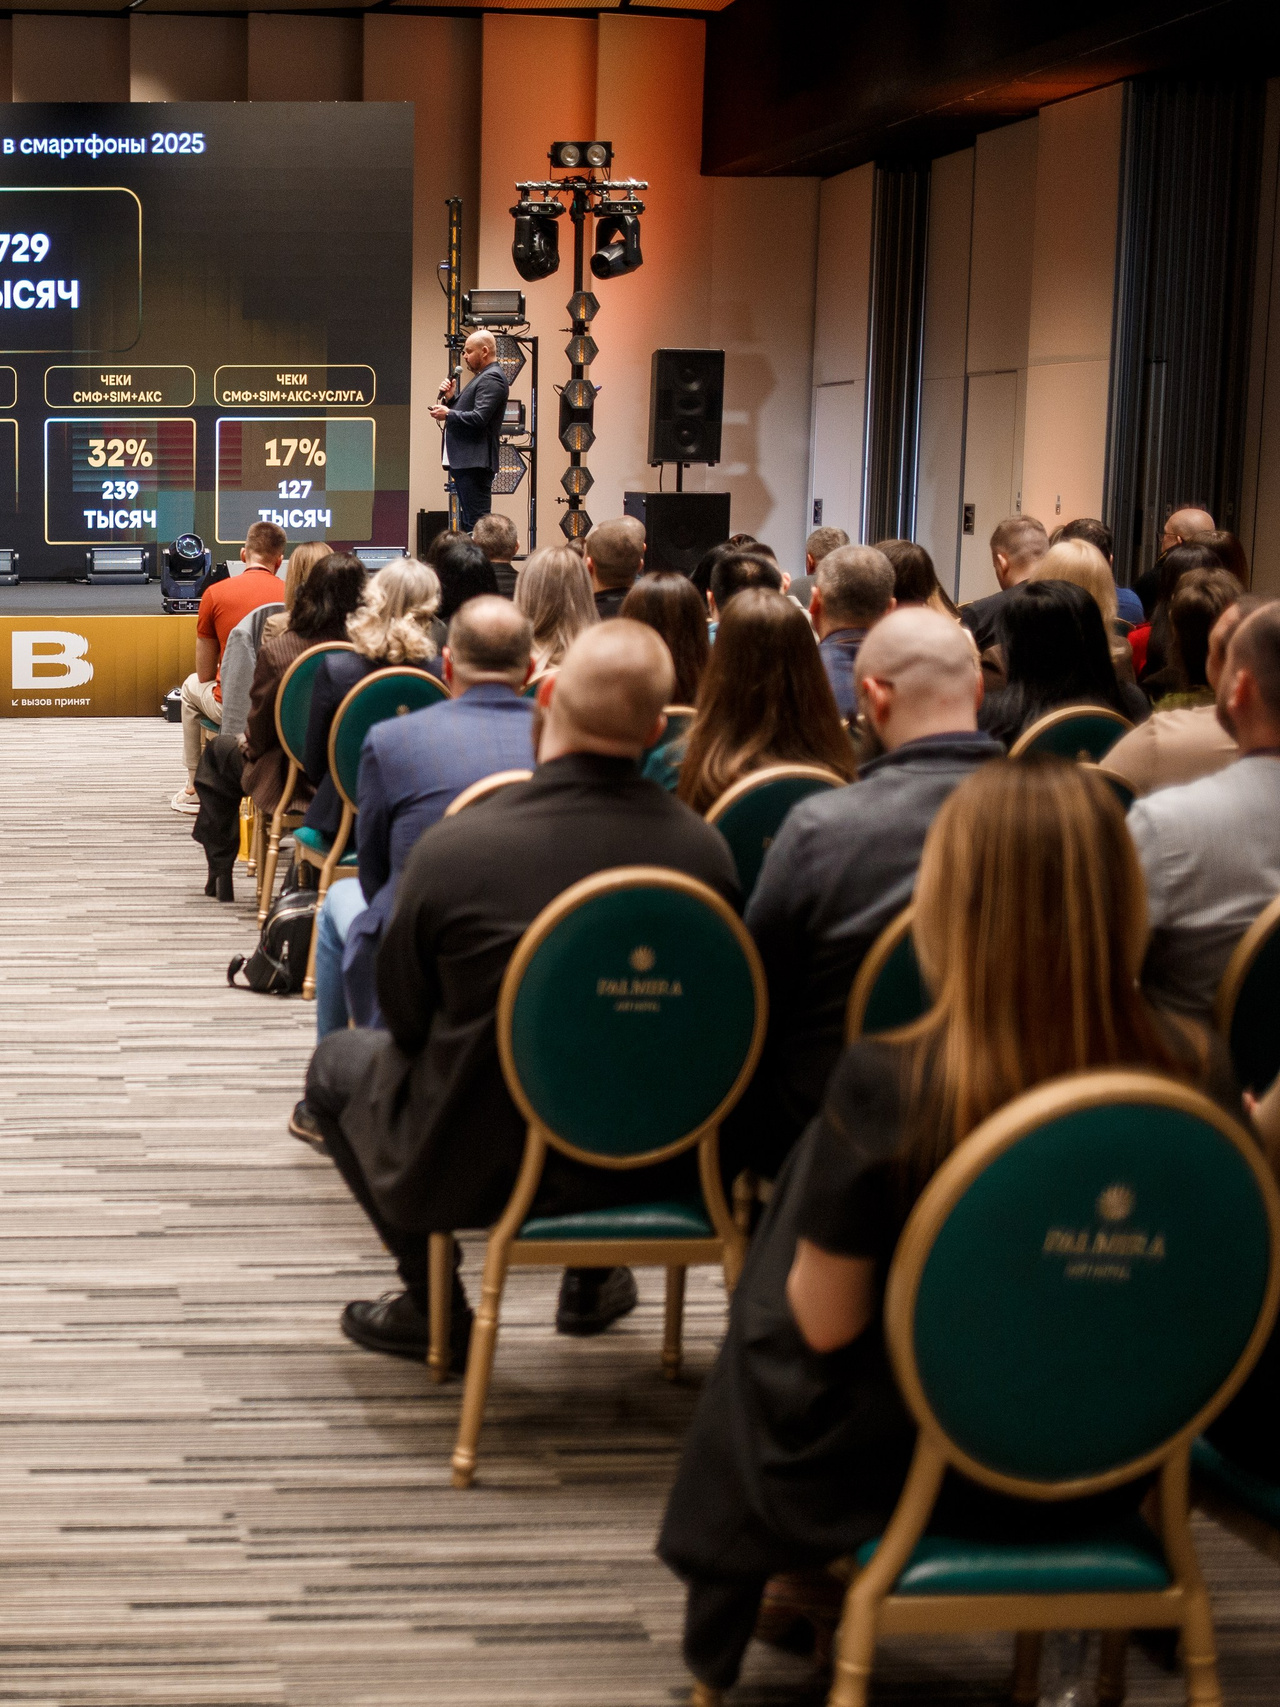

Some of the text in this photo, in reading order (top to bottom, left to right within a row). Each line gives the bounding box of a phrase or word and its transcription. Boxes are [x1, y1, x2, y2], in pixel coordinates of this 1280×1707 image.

[3, 138, 15, 155] в
[19, 133, 146, 160] смартфоны
[151, 132, 205, 154] 2025
[100, 374, 132, 386] ЧЕКИ
[276, 373, 308, 386] ЧЕКИ
[73, 390, 162, 403] СМФ+SIM+АКС
[222, 390, 364, 404] СМФ+SIM+АКС+УСЛУГА
[87, 438, 153, 468] 32%
[265, 438, 327, 467] 17%
[101, 480, 139, 500] 239
[278, 479, 313, 499] 127
[83, 509, 157, 529] ТЫСЯЧ
[258, 508, 331, 528] ТЫСЯЧ
[21, 698, 91, 708] вызов принят
